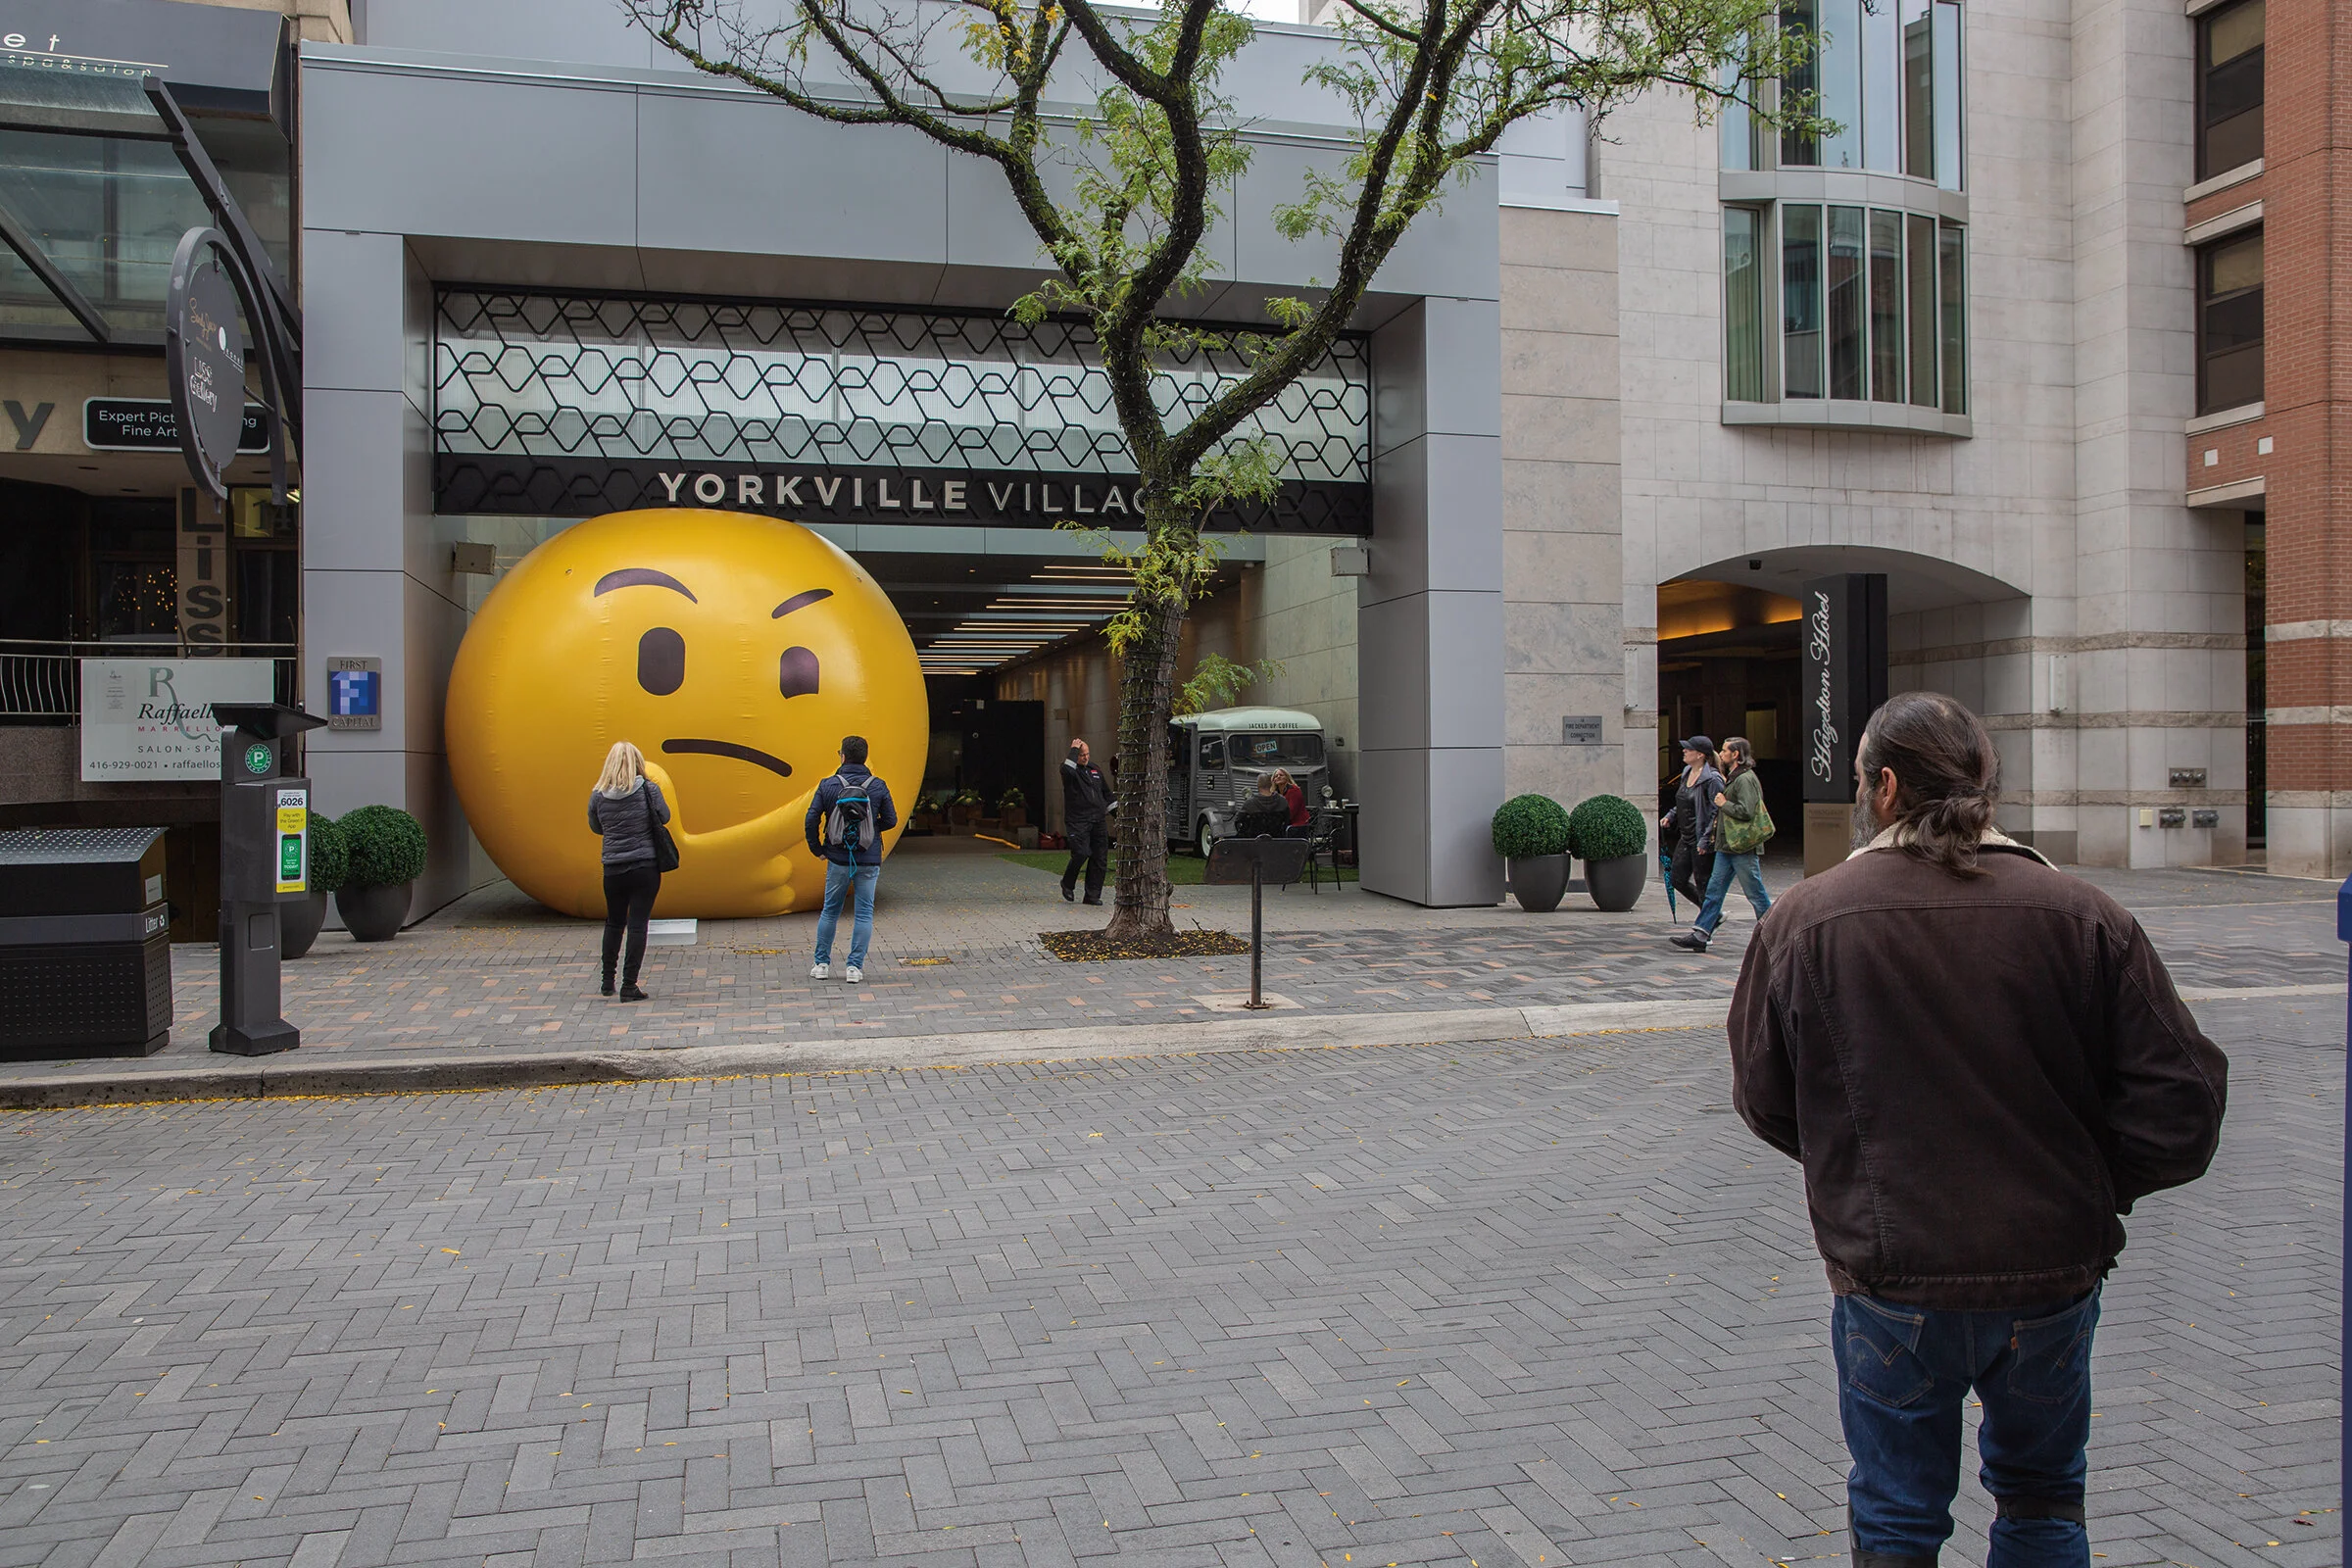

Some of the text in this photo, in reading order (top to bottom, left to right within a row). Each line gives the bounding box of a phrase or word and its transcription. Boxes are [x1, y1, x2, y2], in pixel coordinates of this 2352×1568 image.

[99, 410, 145, 423] Expert
[149, 412, 175, 423] Pict
[122, 424, 177, 437] Fine Art
[659, 472, 1145, 514] YORKVILLE VILLA
[1809, 590, 1831, 665] Hotel
[340, 660, 368, 669] FIRST
[137, 703, 213, 725] Raffaell
[332, 716, 375, 727] CAPITAL
[137, 745, 220, 754] SALON SPA
[1256, 741, 1276, 753] OPEN
[89, 760, 158, 769] 416-929-0021
[280, 797, 304, 807] 6026
[145, 916, 159, 934] Litter
